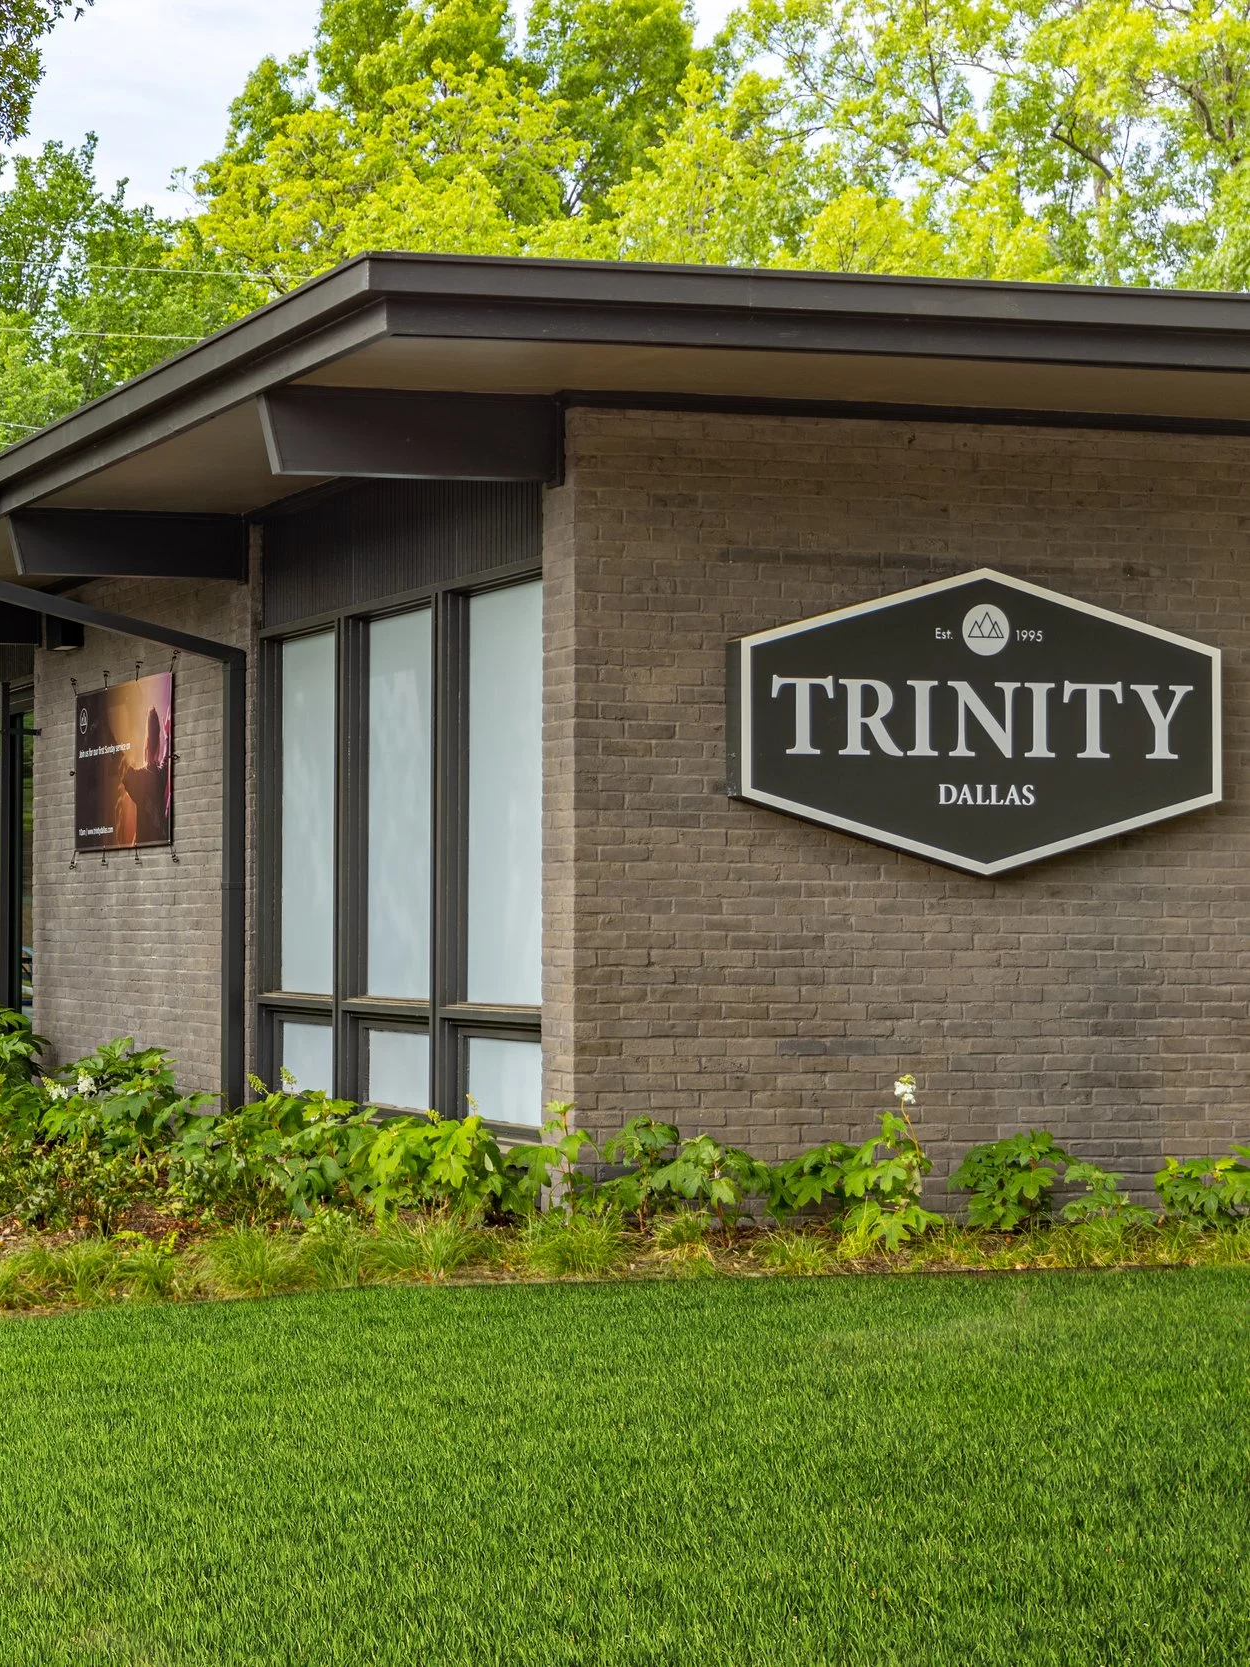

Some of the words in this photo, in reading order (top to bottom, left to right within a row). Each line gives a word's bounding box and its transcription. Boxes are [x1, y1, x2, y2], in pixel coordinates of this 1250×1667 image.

[935, 627, 953, 640] Est.
[1015, 629, 1043, 643] 1995
[771, 674, 1194, 760] TRINITY
[938, 784, 1036, 807] DALLAS
